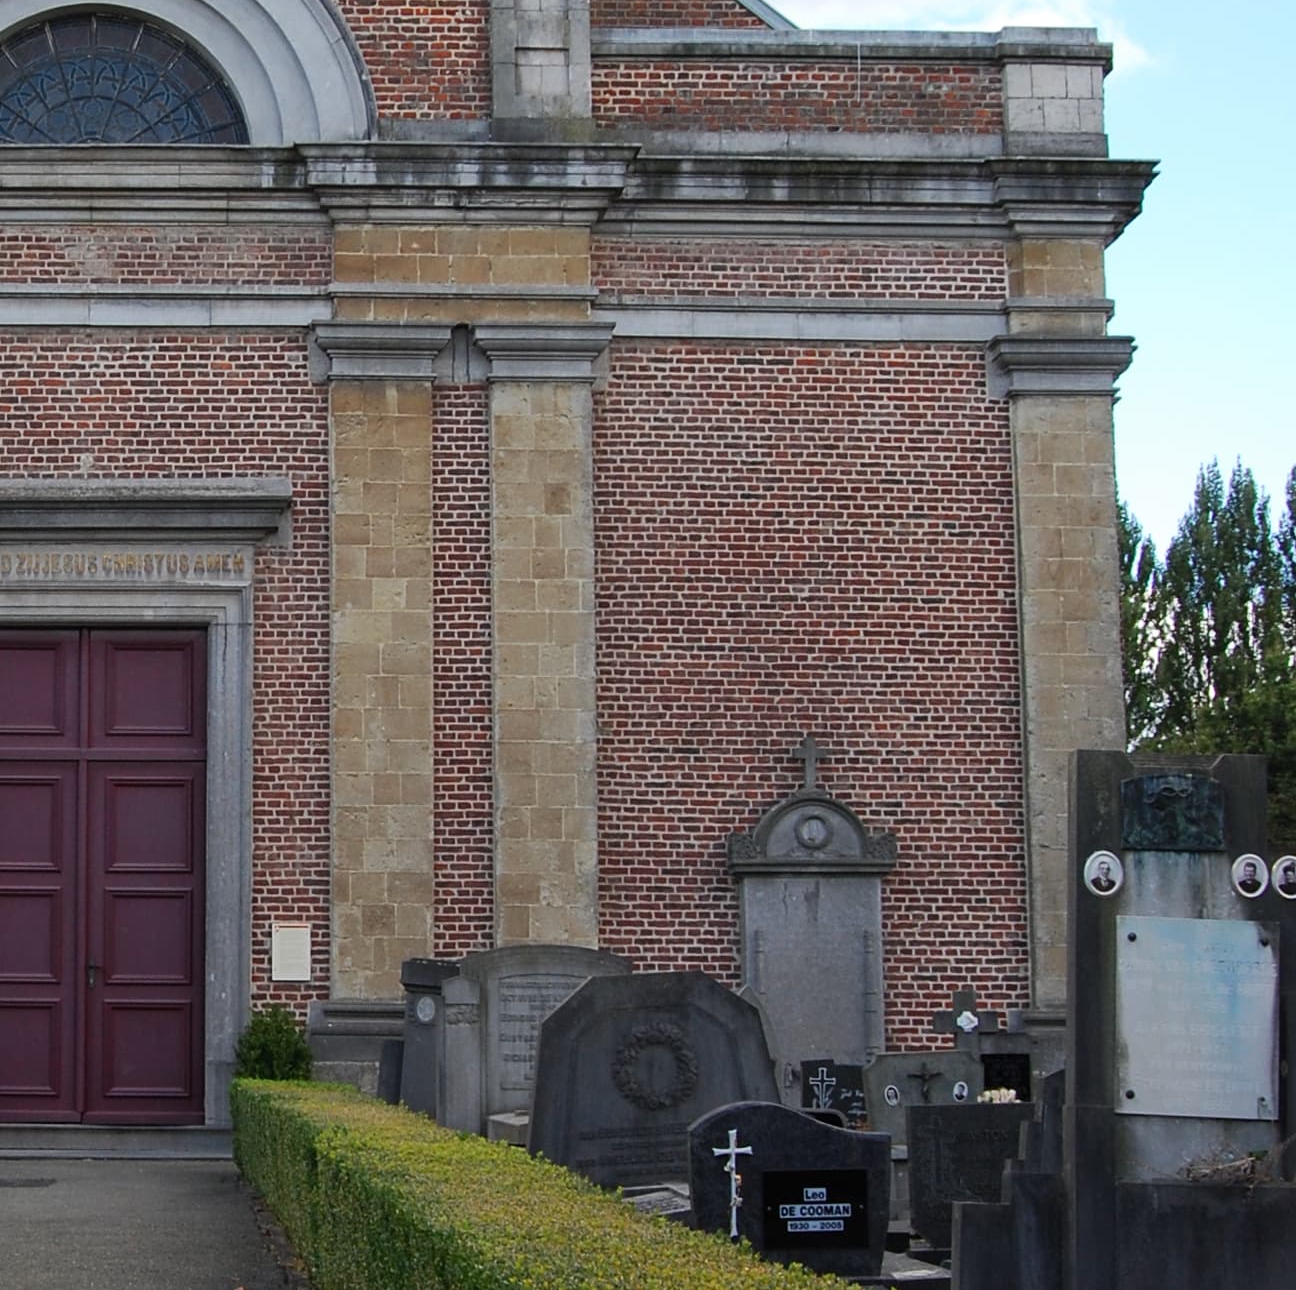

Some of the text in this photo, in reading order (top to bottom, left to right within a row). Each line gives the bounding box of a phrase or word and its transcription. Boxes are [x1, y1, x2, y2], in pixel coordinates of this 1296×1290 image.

[41, 552, 98, 576] JESUS
[102, 552, 190, 576] CHRISTUS
[193, 552, 245, 575] AMEN
[805, 1189, 825, 1200] Leo
[780, 1205, 850, 1217] DE COOMAN
